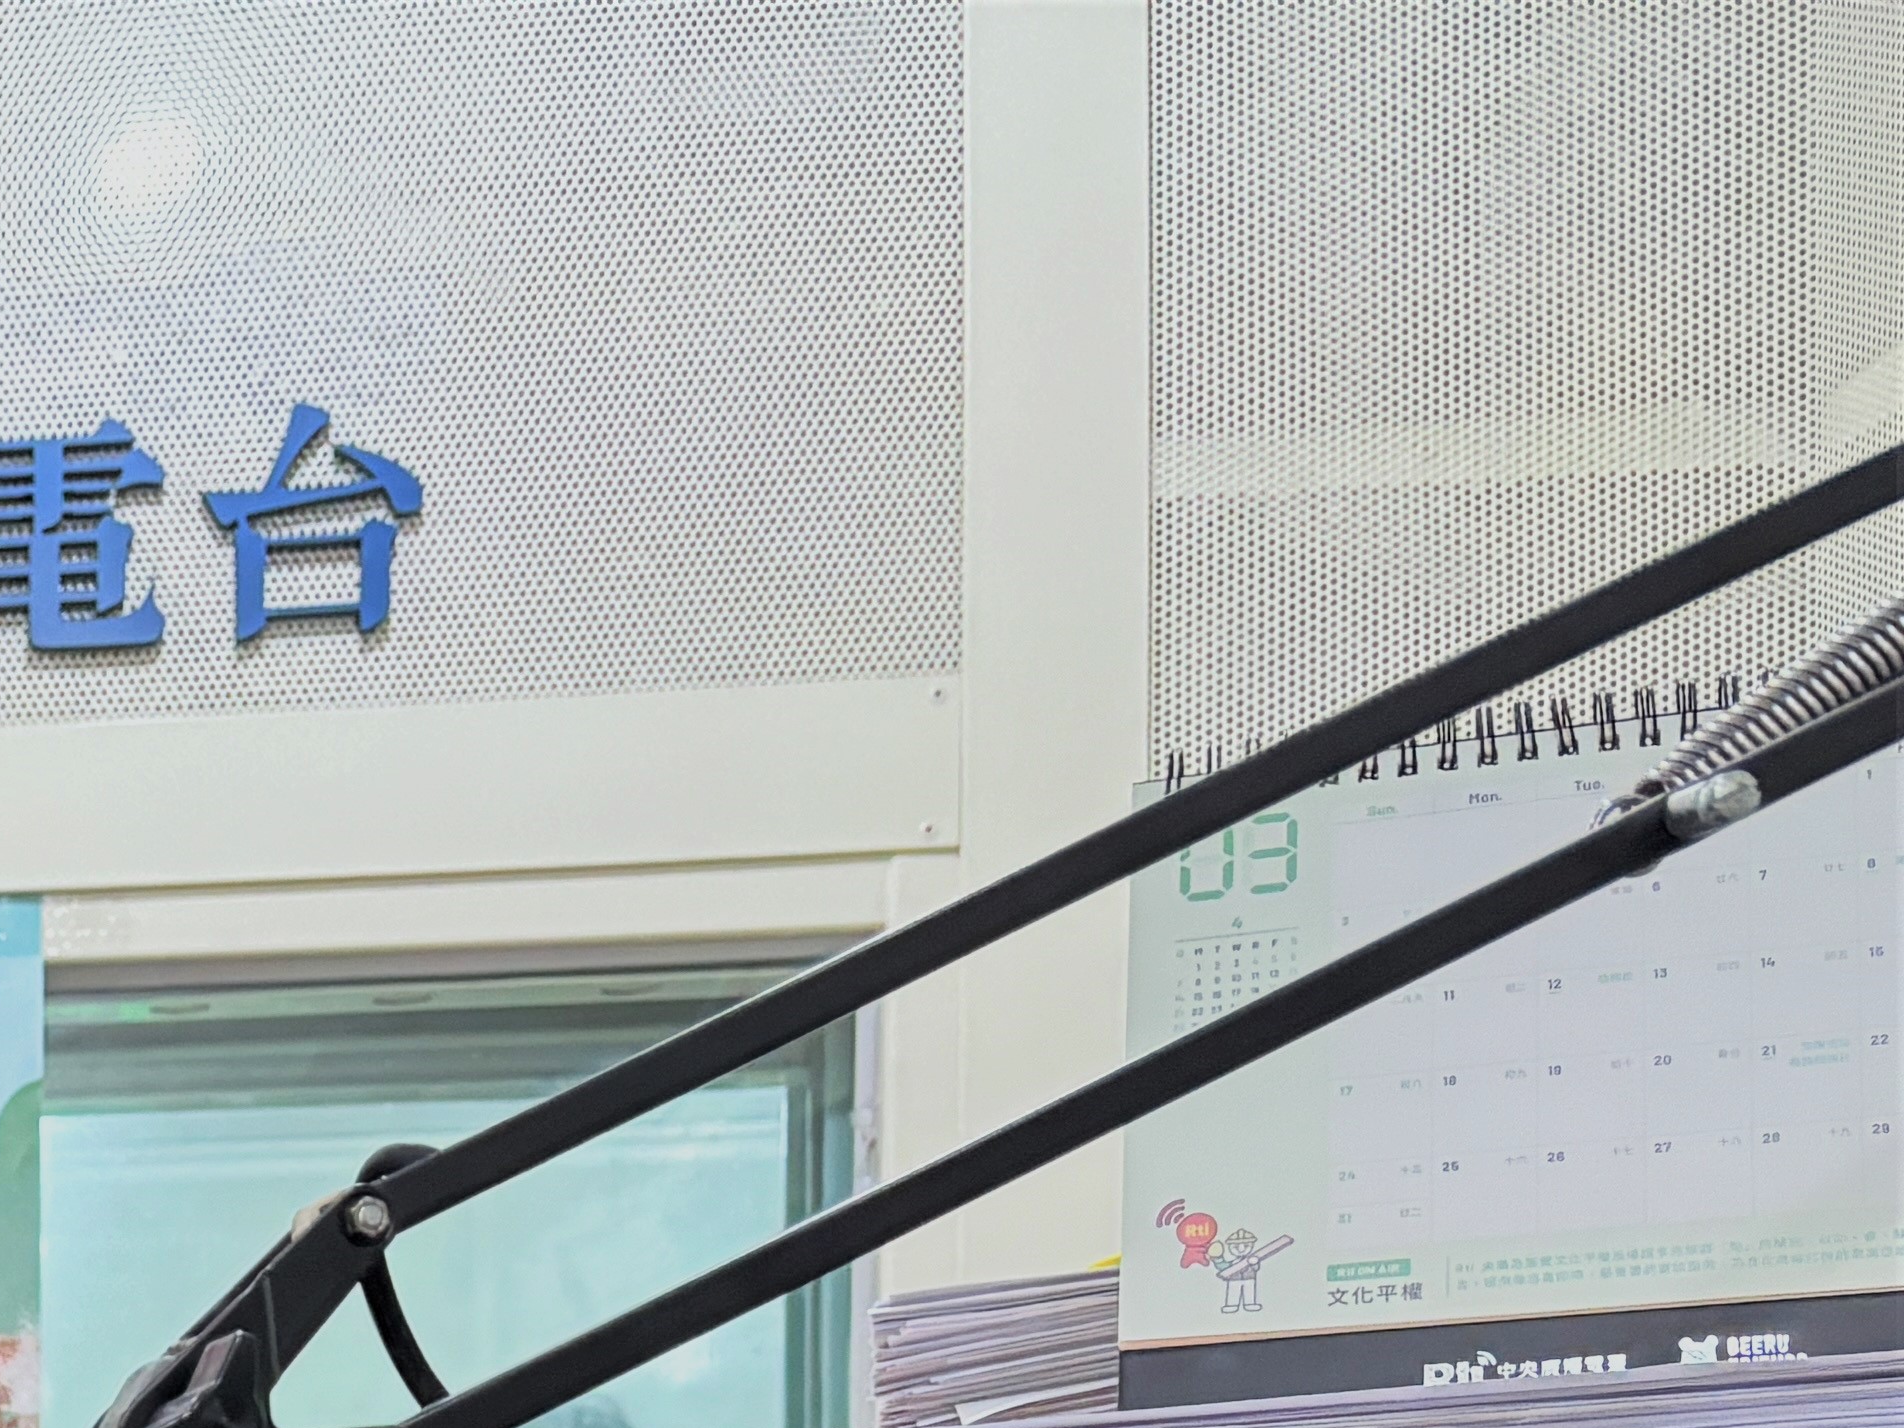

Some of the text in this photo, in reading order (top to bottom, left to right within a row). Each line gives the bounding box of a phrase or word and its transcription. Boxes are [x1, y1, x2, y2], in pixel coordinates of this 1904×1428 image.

[1468, 779, 1605, 805] Mon. Tue.
[1758, 869, 1768, 881] 7
[1759, 956, 1776, 968] 14
[1653, 967, 1668, 979] 13
[1547, 978, 1563, 990] 12
[1870, 1034, 1889, 1046] 22
[1760, 1045, 1777, 1057] 21
[1653, 1055, 1672, 1066] 20
[1654, 1141, 1672, 1153] 27
[1327, 1281, 1424, 1307] 文化平權
